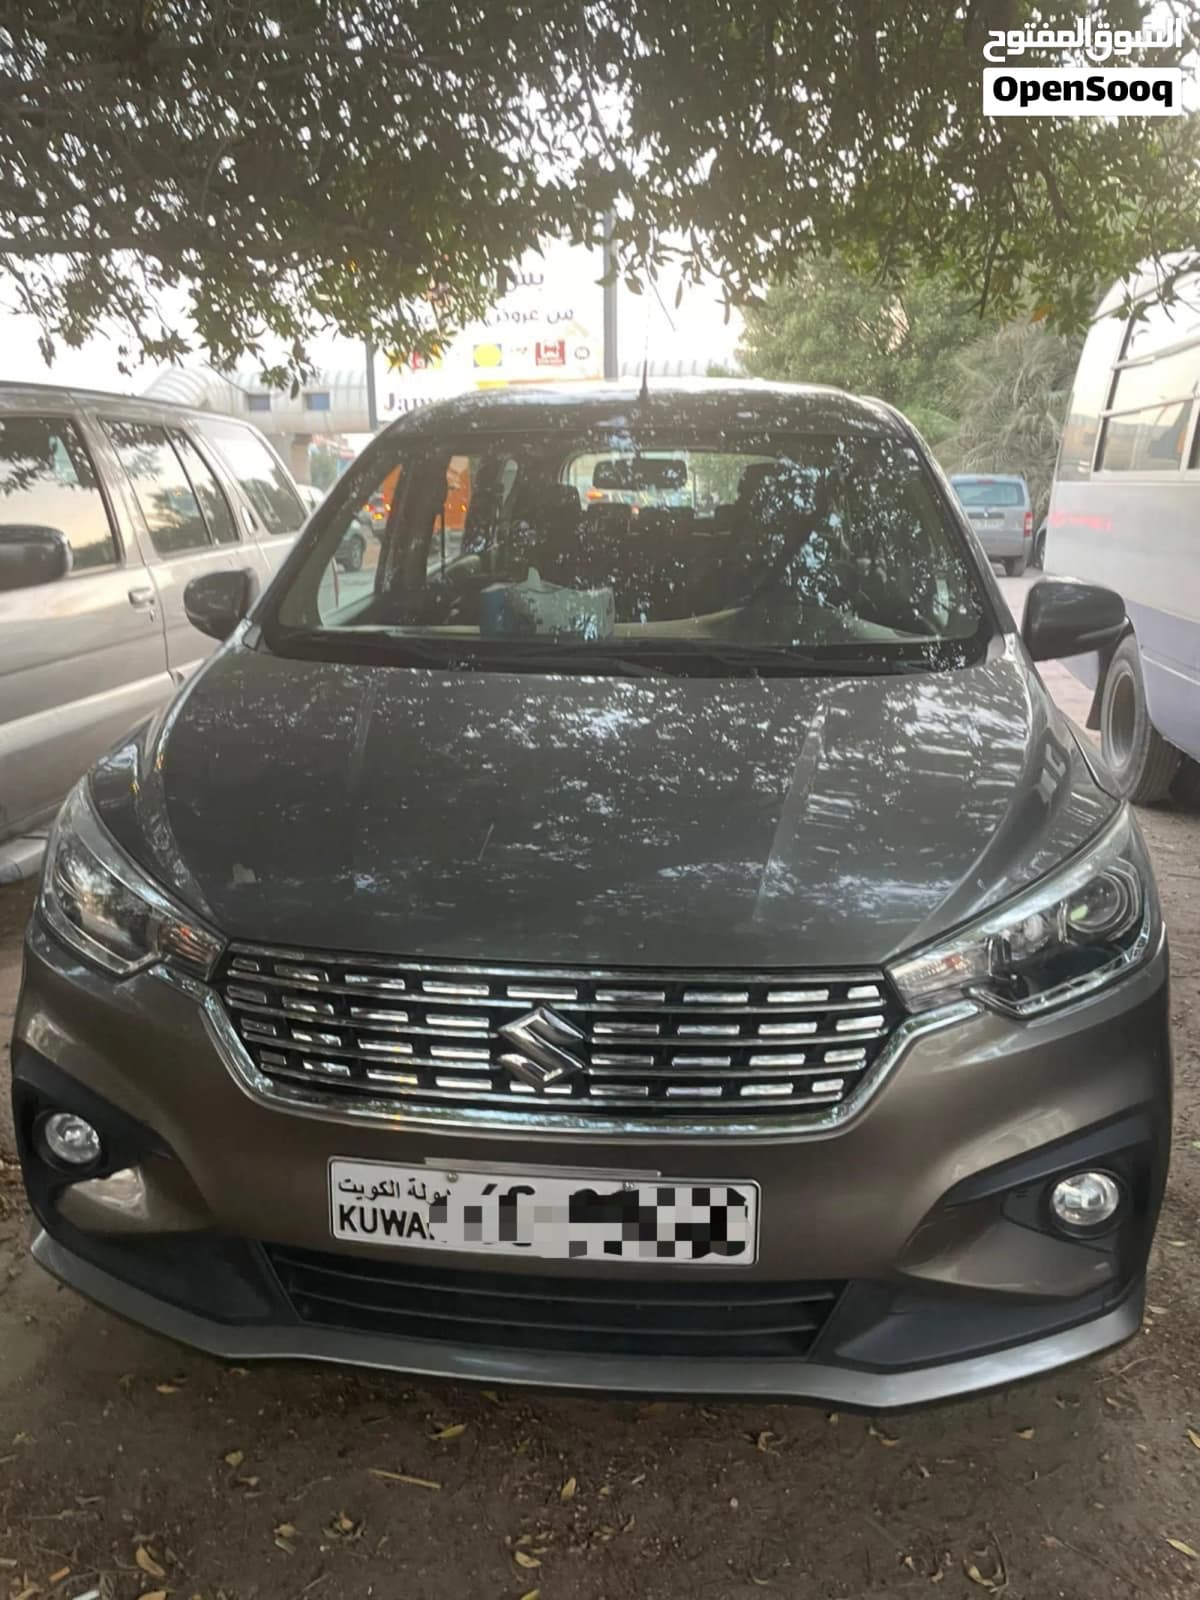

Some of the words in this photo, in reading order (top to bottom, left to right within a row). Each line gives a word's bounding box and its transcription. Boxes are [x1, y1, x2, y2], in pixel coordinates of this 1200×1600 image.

[338, 1178, 401, 1201] الكويت
[408, 1177, 452, 1206] ولة
[338, 1204, 436, 1241] KUWA
